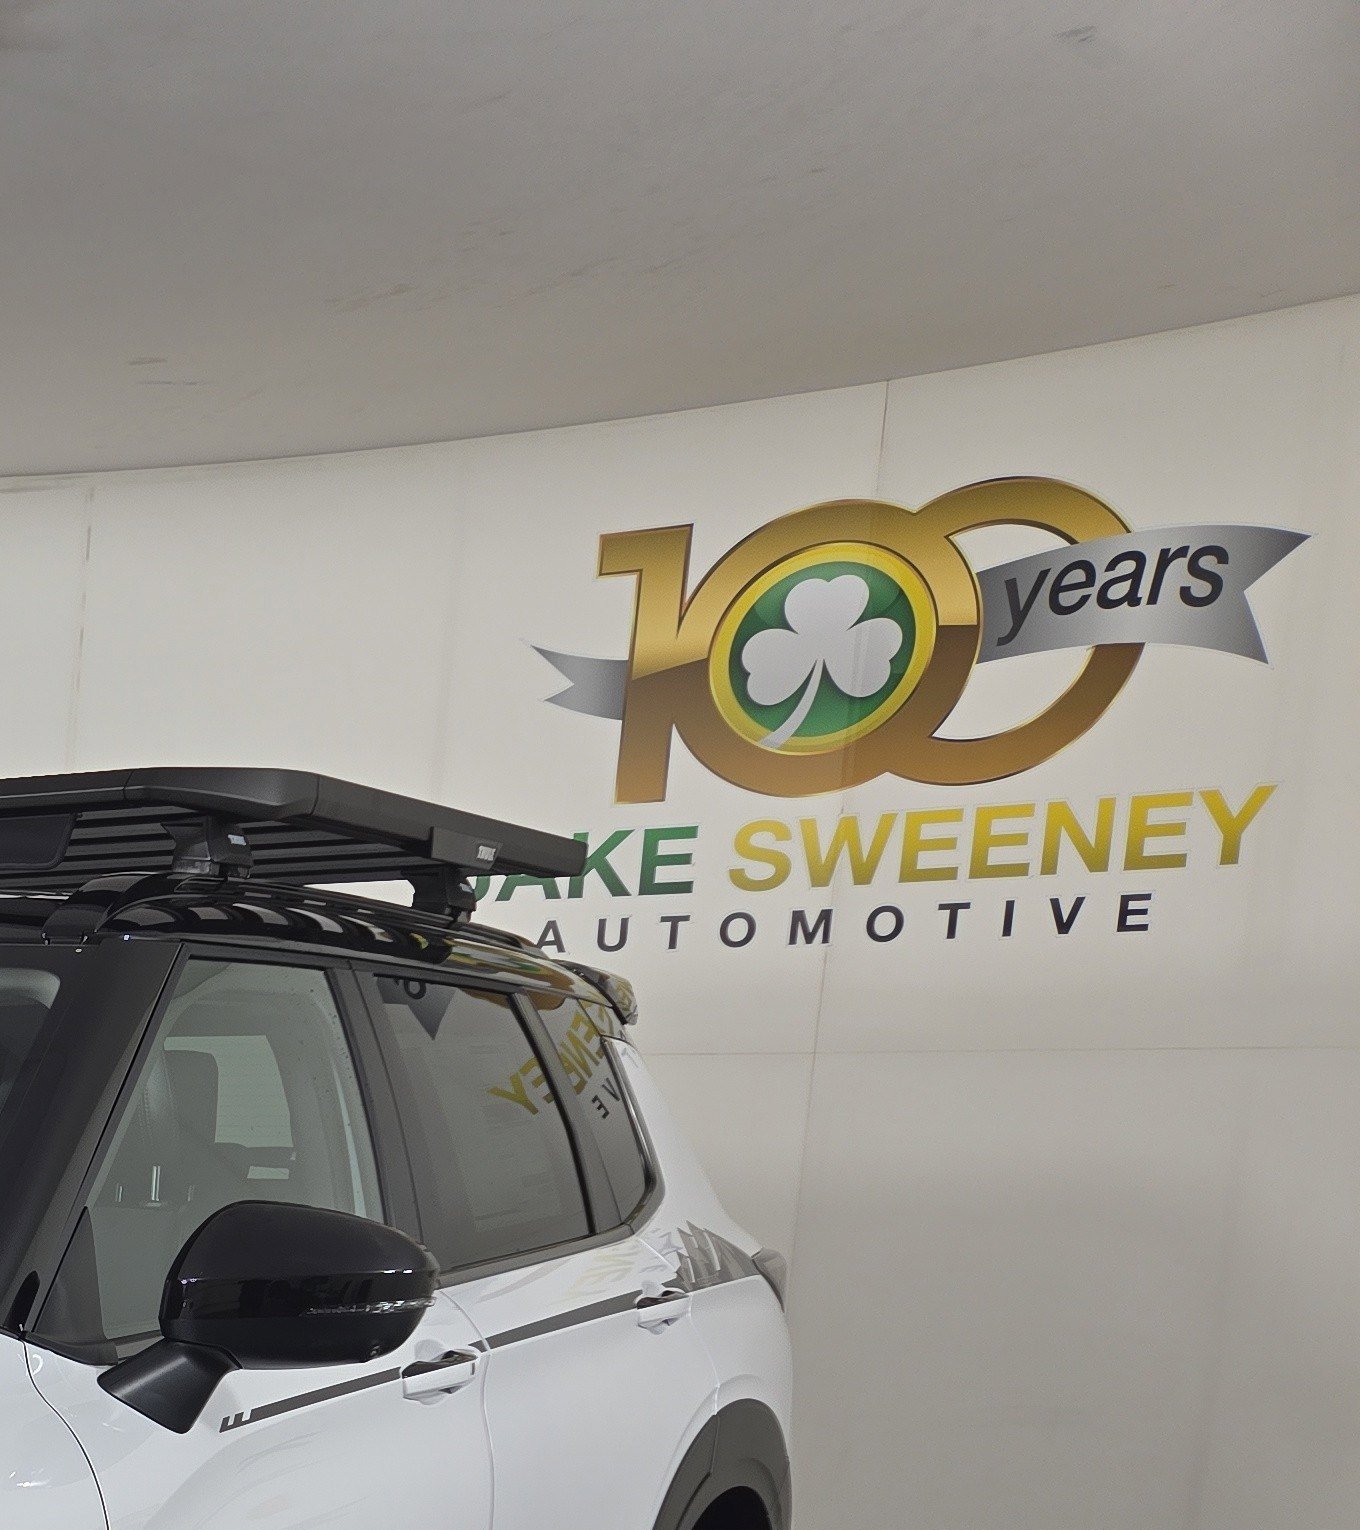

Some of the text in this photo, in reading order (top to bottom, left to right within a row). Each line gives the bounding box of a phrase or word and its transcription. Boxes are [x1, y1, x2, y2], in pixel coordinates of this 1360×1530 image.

[597, 475, 1230, 804] 100 years
[728, 784, 1279, 893] SWEENEY
[534, 892, 1153, 954] AUTOMOTIVE
